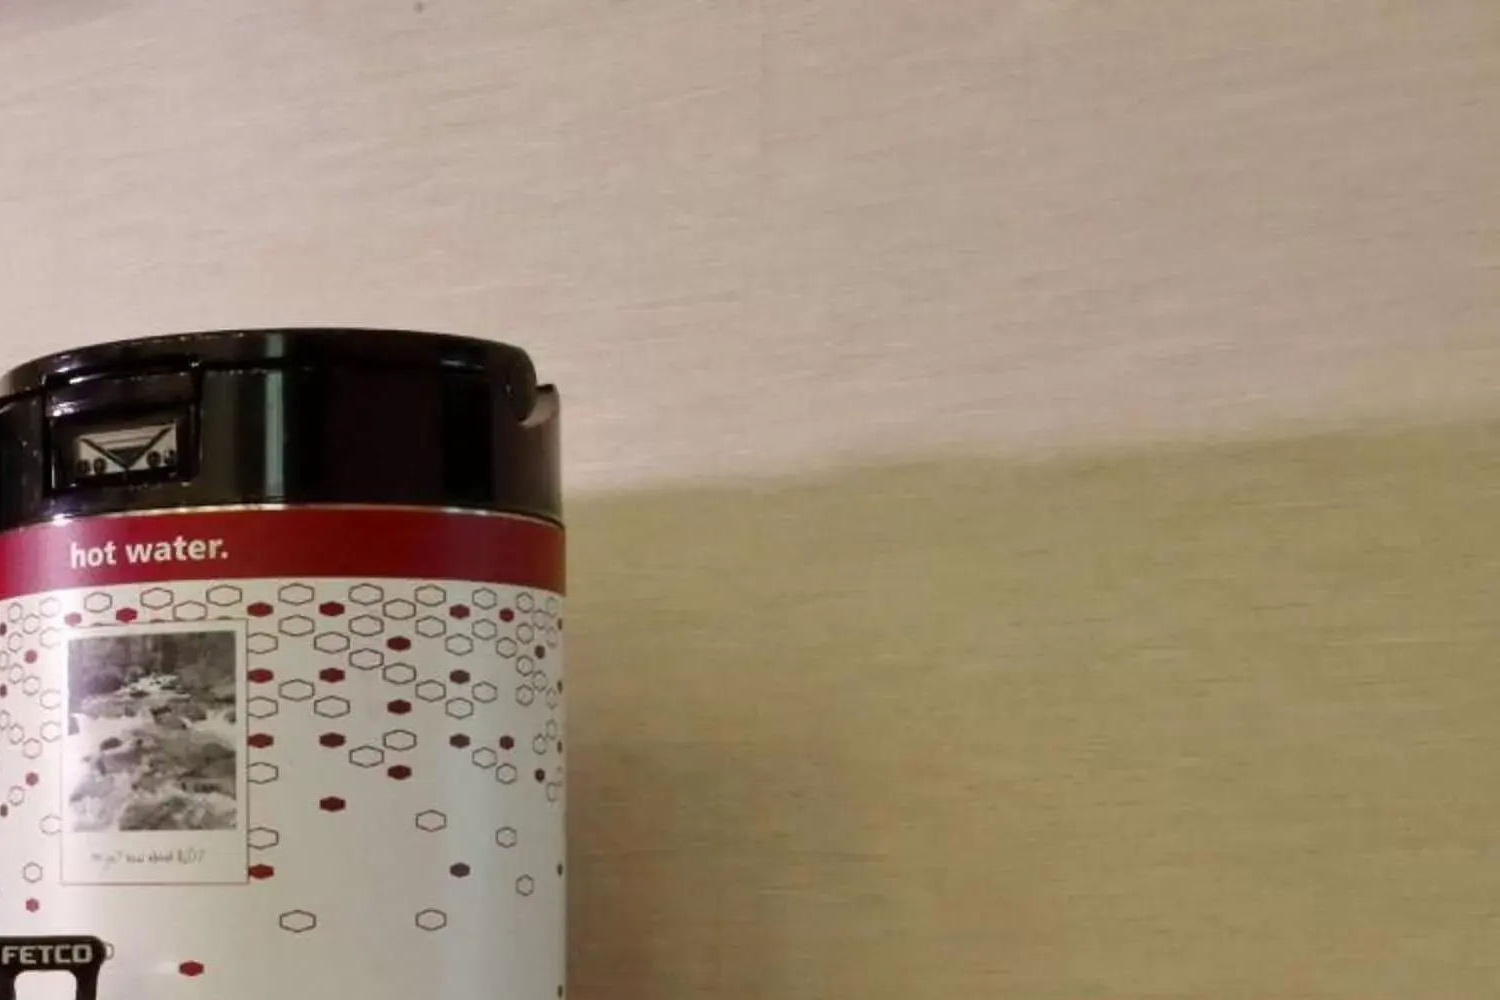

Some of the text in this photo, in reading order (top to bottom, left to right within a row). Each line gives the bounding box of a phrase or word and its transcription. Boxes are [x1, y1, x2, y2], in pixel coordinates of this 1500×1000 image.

[70, 535, 229, 569] hot water.
[1, 944, 93, 965] FETCO
